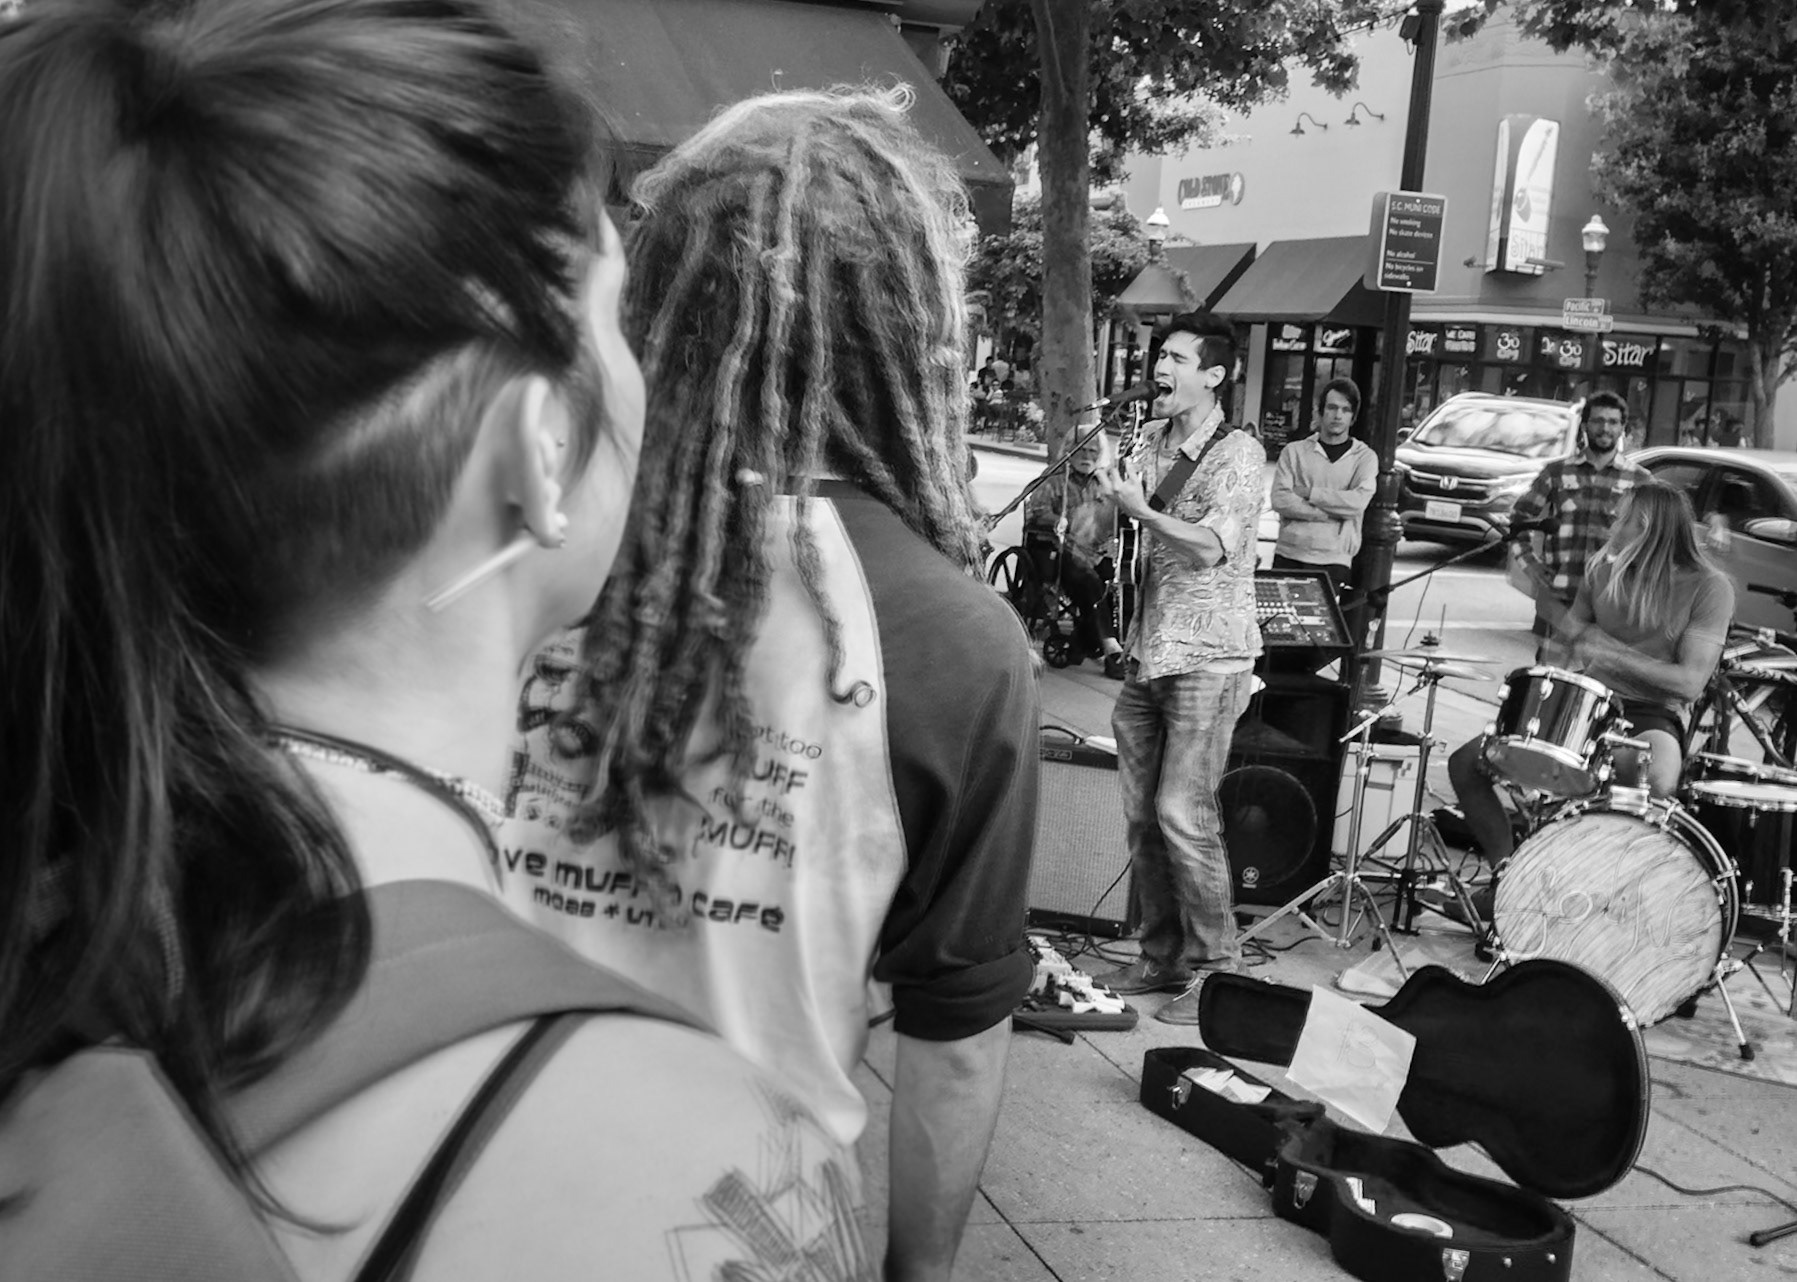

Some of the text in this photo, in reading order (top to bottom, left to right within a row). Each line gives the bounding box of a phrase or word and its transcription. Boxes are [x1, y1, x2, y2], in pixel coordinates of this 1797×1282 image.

[1404, 202, 1422, 213] MUNI
[1423, 204, 1441, 214] CODE
[1390, 217, 1421, 228] No smoking
[1389, 228, 1398, 236] No
[1414, 231, 1433, 239] devices
[1386, 249, 1416, 259] No alcohol
[1385, 262, 1394, 270] No
[1395, 263, 1415, 272] bicycles
[1384, 272, 1410, 281] sidewalks
[1566, 301, 1590, 312] Pacific
[1565, 316, 1598, 328] Lincoln
[1406, 329, 1438, 355] Sitar
[1602, 339, 1654, 367] Sitar
[780, 731, 822, 759] too
[751, 760, 808, 794] UFF
[761, 798, 795, 828] the
[700, 816, 796, 868] MUFF!
